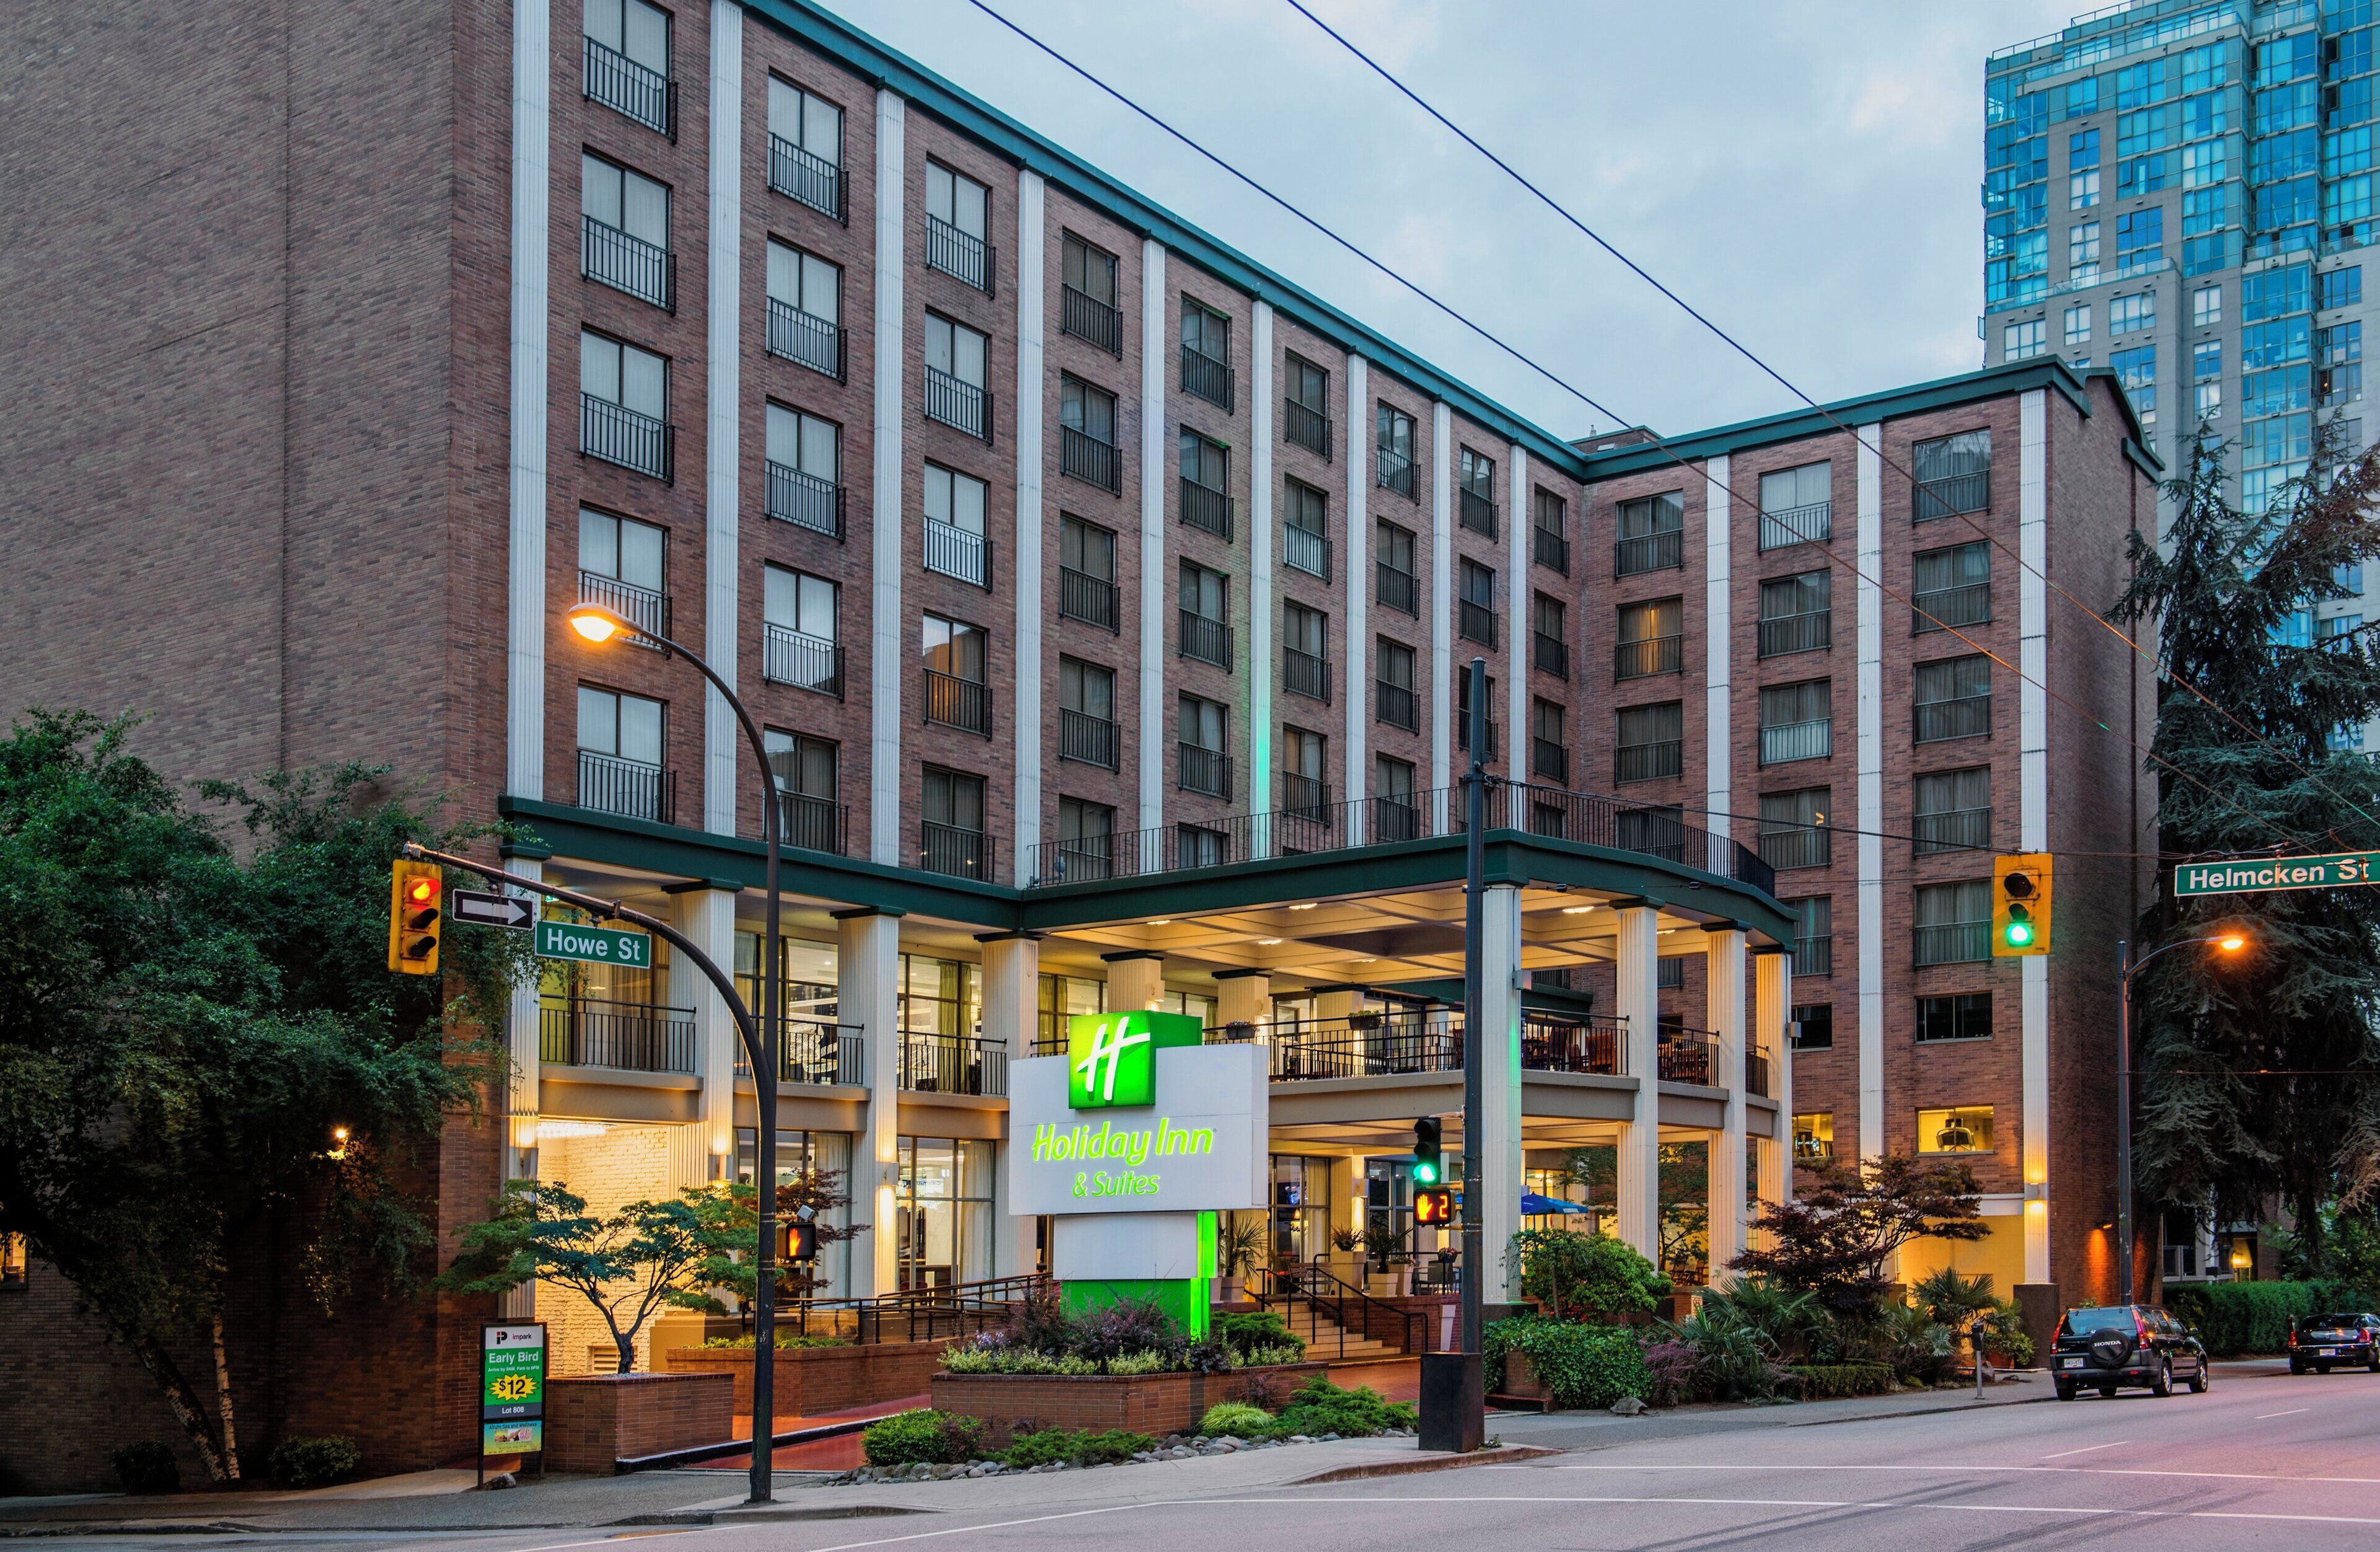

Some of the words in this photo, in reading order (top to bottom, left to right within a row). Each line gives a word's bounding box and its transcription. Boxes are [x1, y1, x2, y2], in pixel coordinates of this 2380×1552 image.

[2189, 865, 2324, 889] Helmcken
[2338, 858, 2369, 881] St
[547, 928, 608, 957] Howe
[618, 937, 640, 961] St
[1031, 1120, 1152, 1166] Holiday
[1155, 1117, 1215, 1155] Inn
[1072, 1171, 1087, 1197] &
[1091, 1171, 1160, 1197] Suites
[489, 1352, 514, 1365] Early
[518, 1351, 539, 1362] Bird
[499, 1379, 526, 1395] $12
